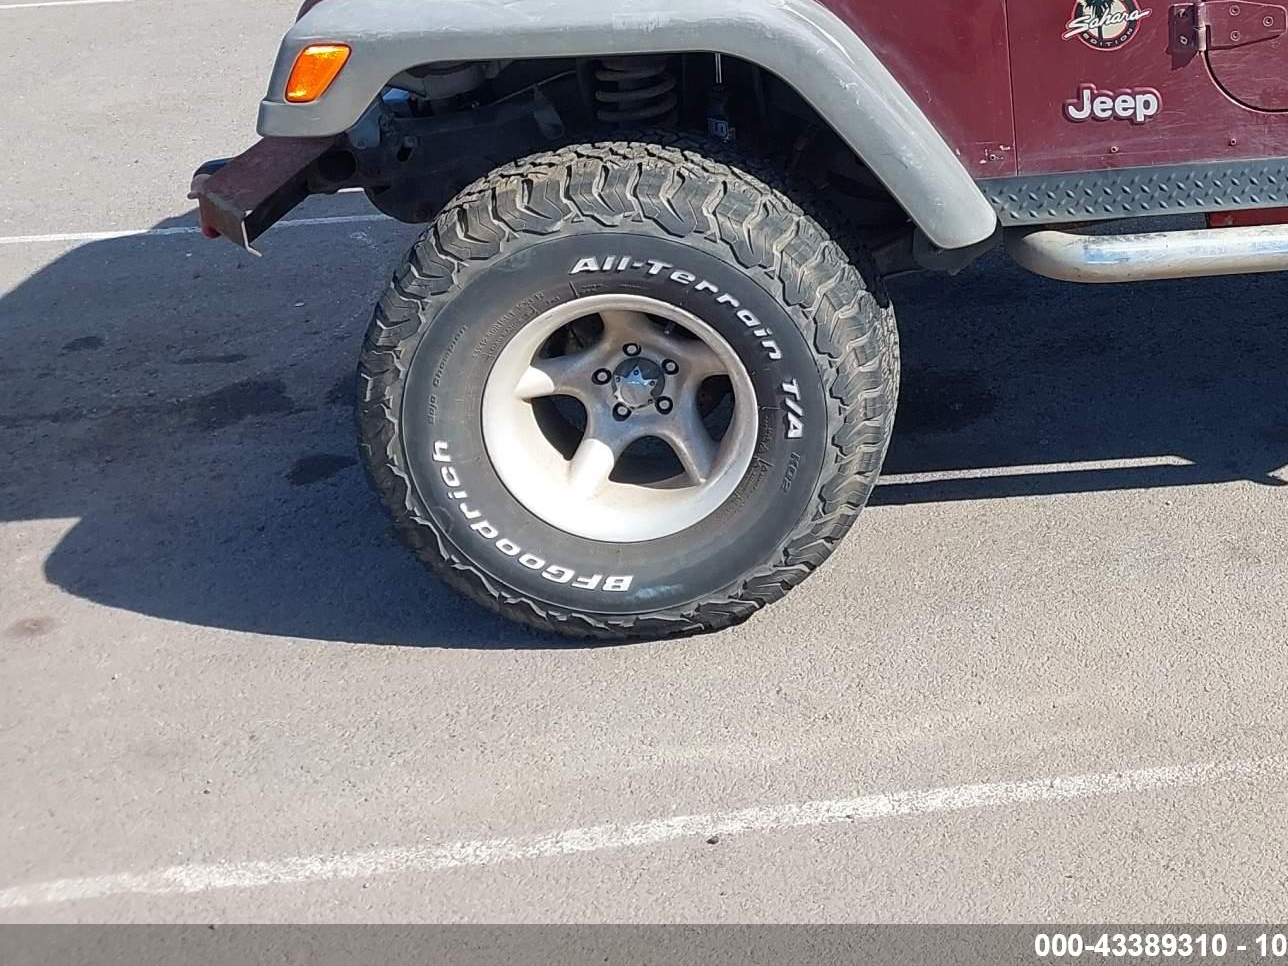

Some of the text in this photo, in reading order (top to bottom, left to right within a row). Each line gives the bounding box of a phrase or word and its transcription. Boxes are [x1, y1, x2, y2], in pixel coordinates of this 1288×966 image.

[1063, 8, 1151, 39] Sahara
[1083, 28, 1134, 46] EDITION
[1067, 90, 1158, 122] Jeep
[570, 255, 782, 361] All-Terrain
[777, 378, 803, 440] T/A
[431, 441, 634, 593] BFGoodrich
